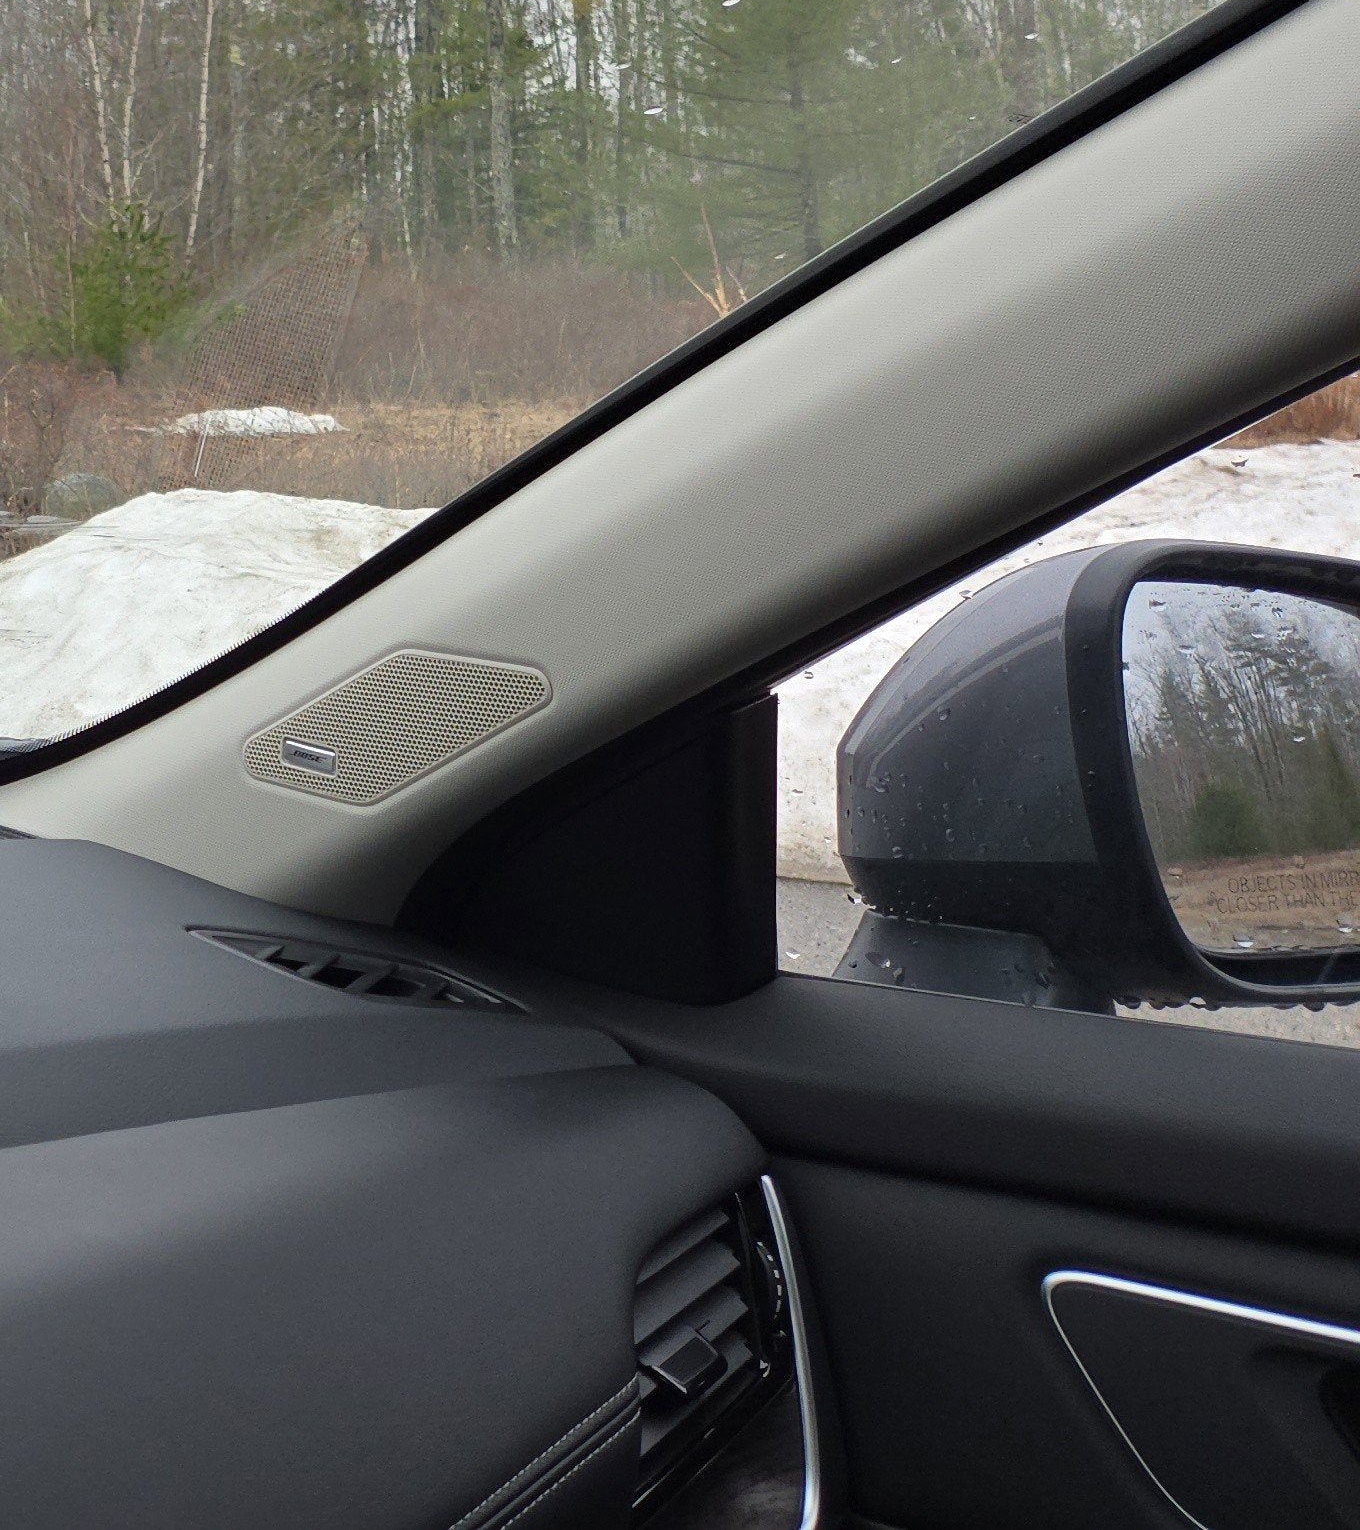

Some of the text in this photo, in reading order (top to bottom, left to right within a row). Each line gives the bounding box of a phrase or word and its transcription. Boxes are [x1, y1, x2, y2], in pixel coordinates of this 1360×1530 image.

[1228, 873, 1296, 893] OBJECTS
[1300, 873, 1317, 890] IN
[1217, 894, 1279, 913] CLOSER
[1283, 890, 1325, 909] THAN
